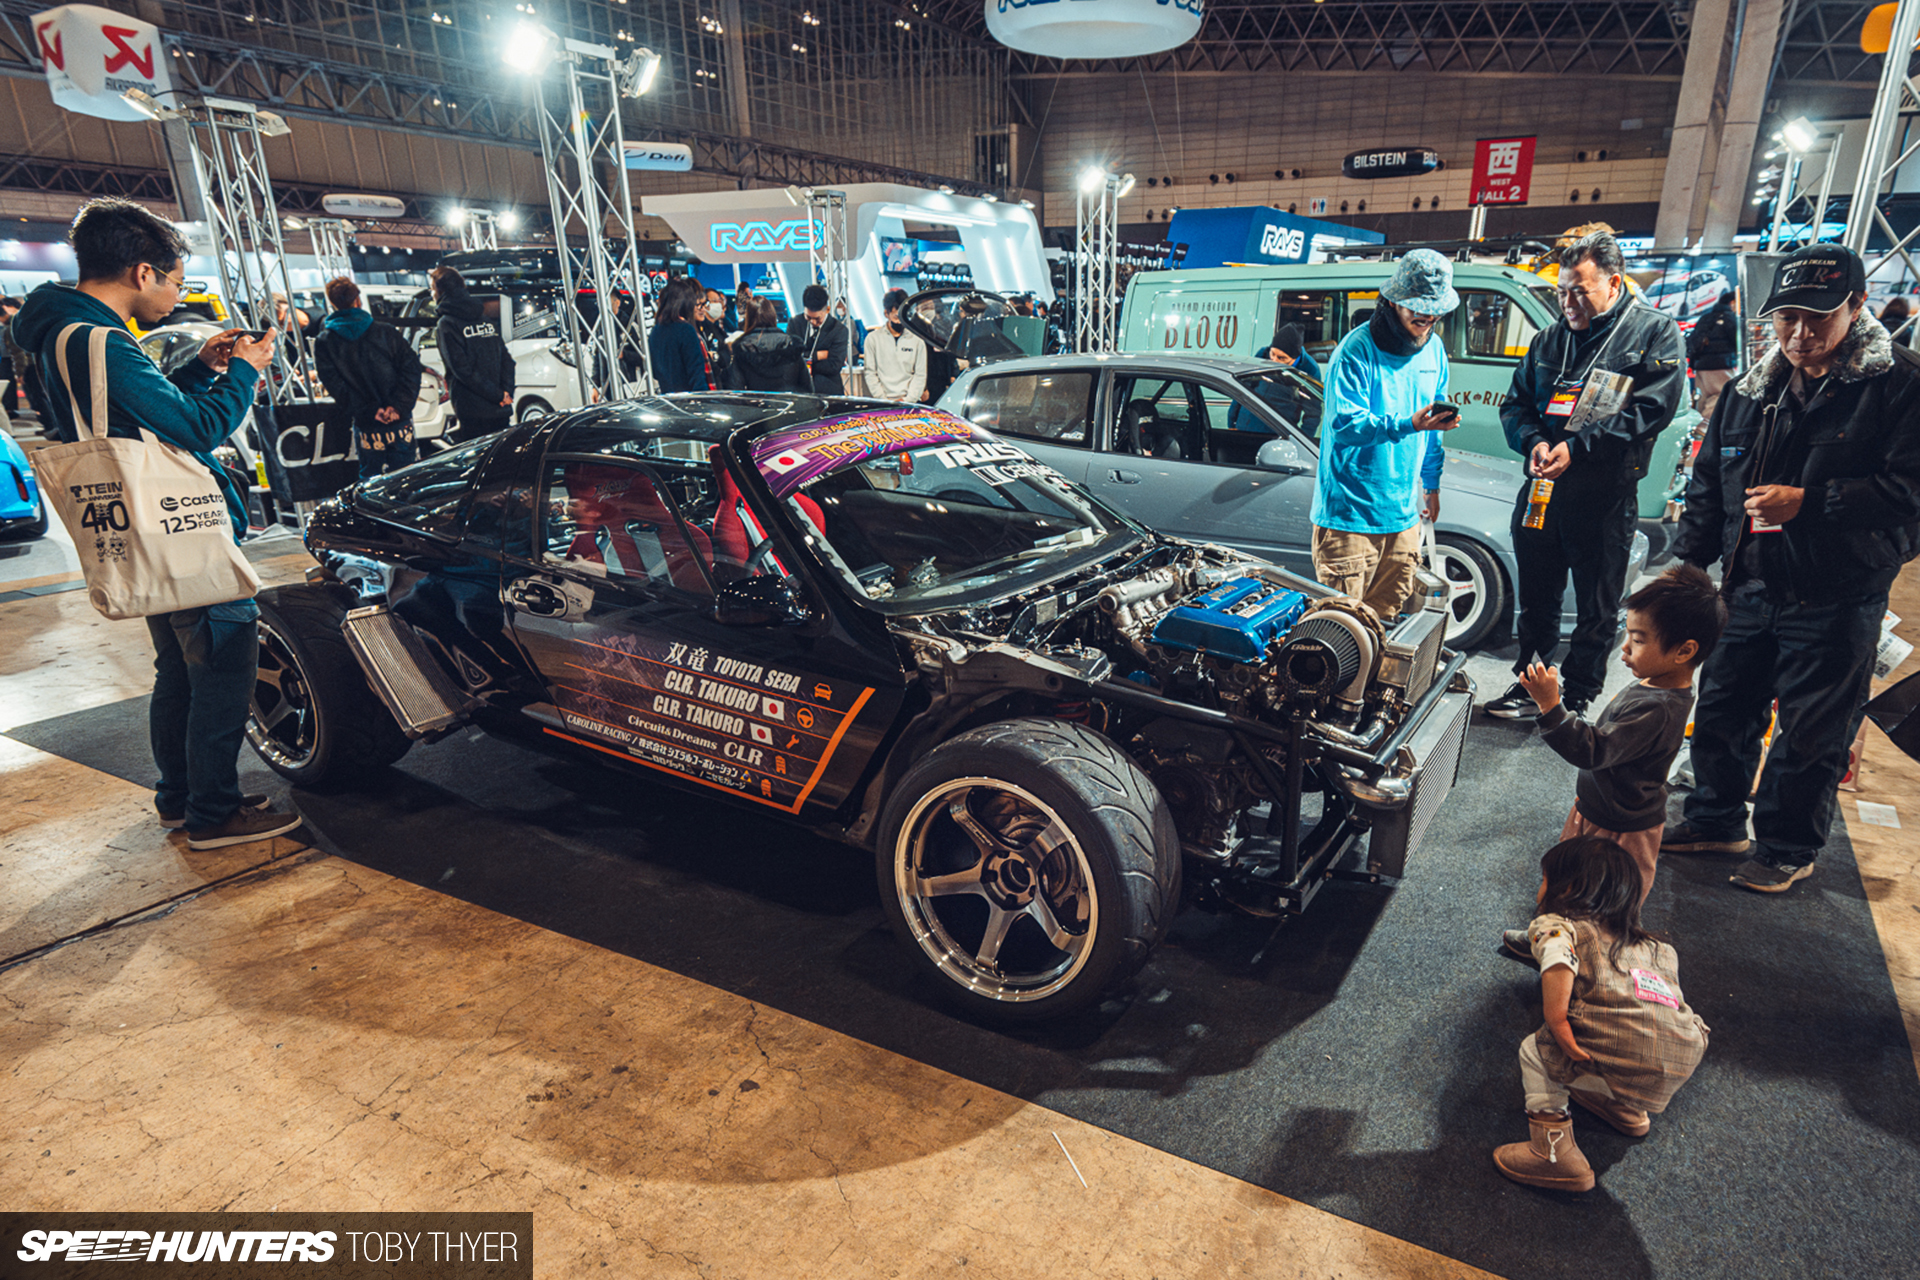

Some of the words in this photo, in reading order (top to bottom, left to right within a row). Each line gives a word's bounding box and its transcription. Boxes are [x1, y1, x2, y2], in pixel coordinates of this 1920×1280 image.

[649, 152, 686, 161] Defi
[1353, 152, 1406, 169] BILSTEIN
[1487, 142, 1522, 175] 西
[1477, 191, 1506, 201] HALL
[1509, 186, 1521, 200] 2
[1490, 178, 1511, 186] WEST
[710, 219, 824, 253] RAYS
[1260, 224, 1304, 259] RAYS
[1201, 302, 1237, 312] FACTORY
[809, 441, 862, 460] The
[849, 425, 909, 453] TWIN
[914, 443, 1035, 469] TRUST
[83, 481, 123, 495] TEIN
[181, 493, 224, 507] Castro
[81, 500, 130, 534] 40
[160, 514, 198, 535] 125
[664, 642, 708, 672] 双竜
[713, 656, 763, 684] TOYOTA
[764, 669, 801, 693] SERA
[664, 670, 694, 696] CLR.
[697, 679, 759, 712] TAKURO
[567, 714, 604, 733] CAROLINE
[603, 726, 632, 742] RACING
[653, 695, 682, 719] CLR.
[686, 704, 744, 736] TAKURO
[724, 741, 763, 766] CLR
